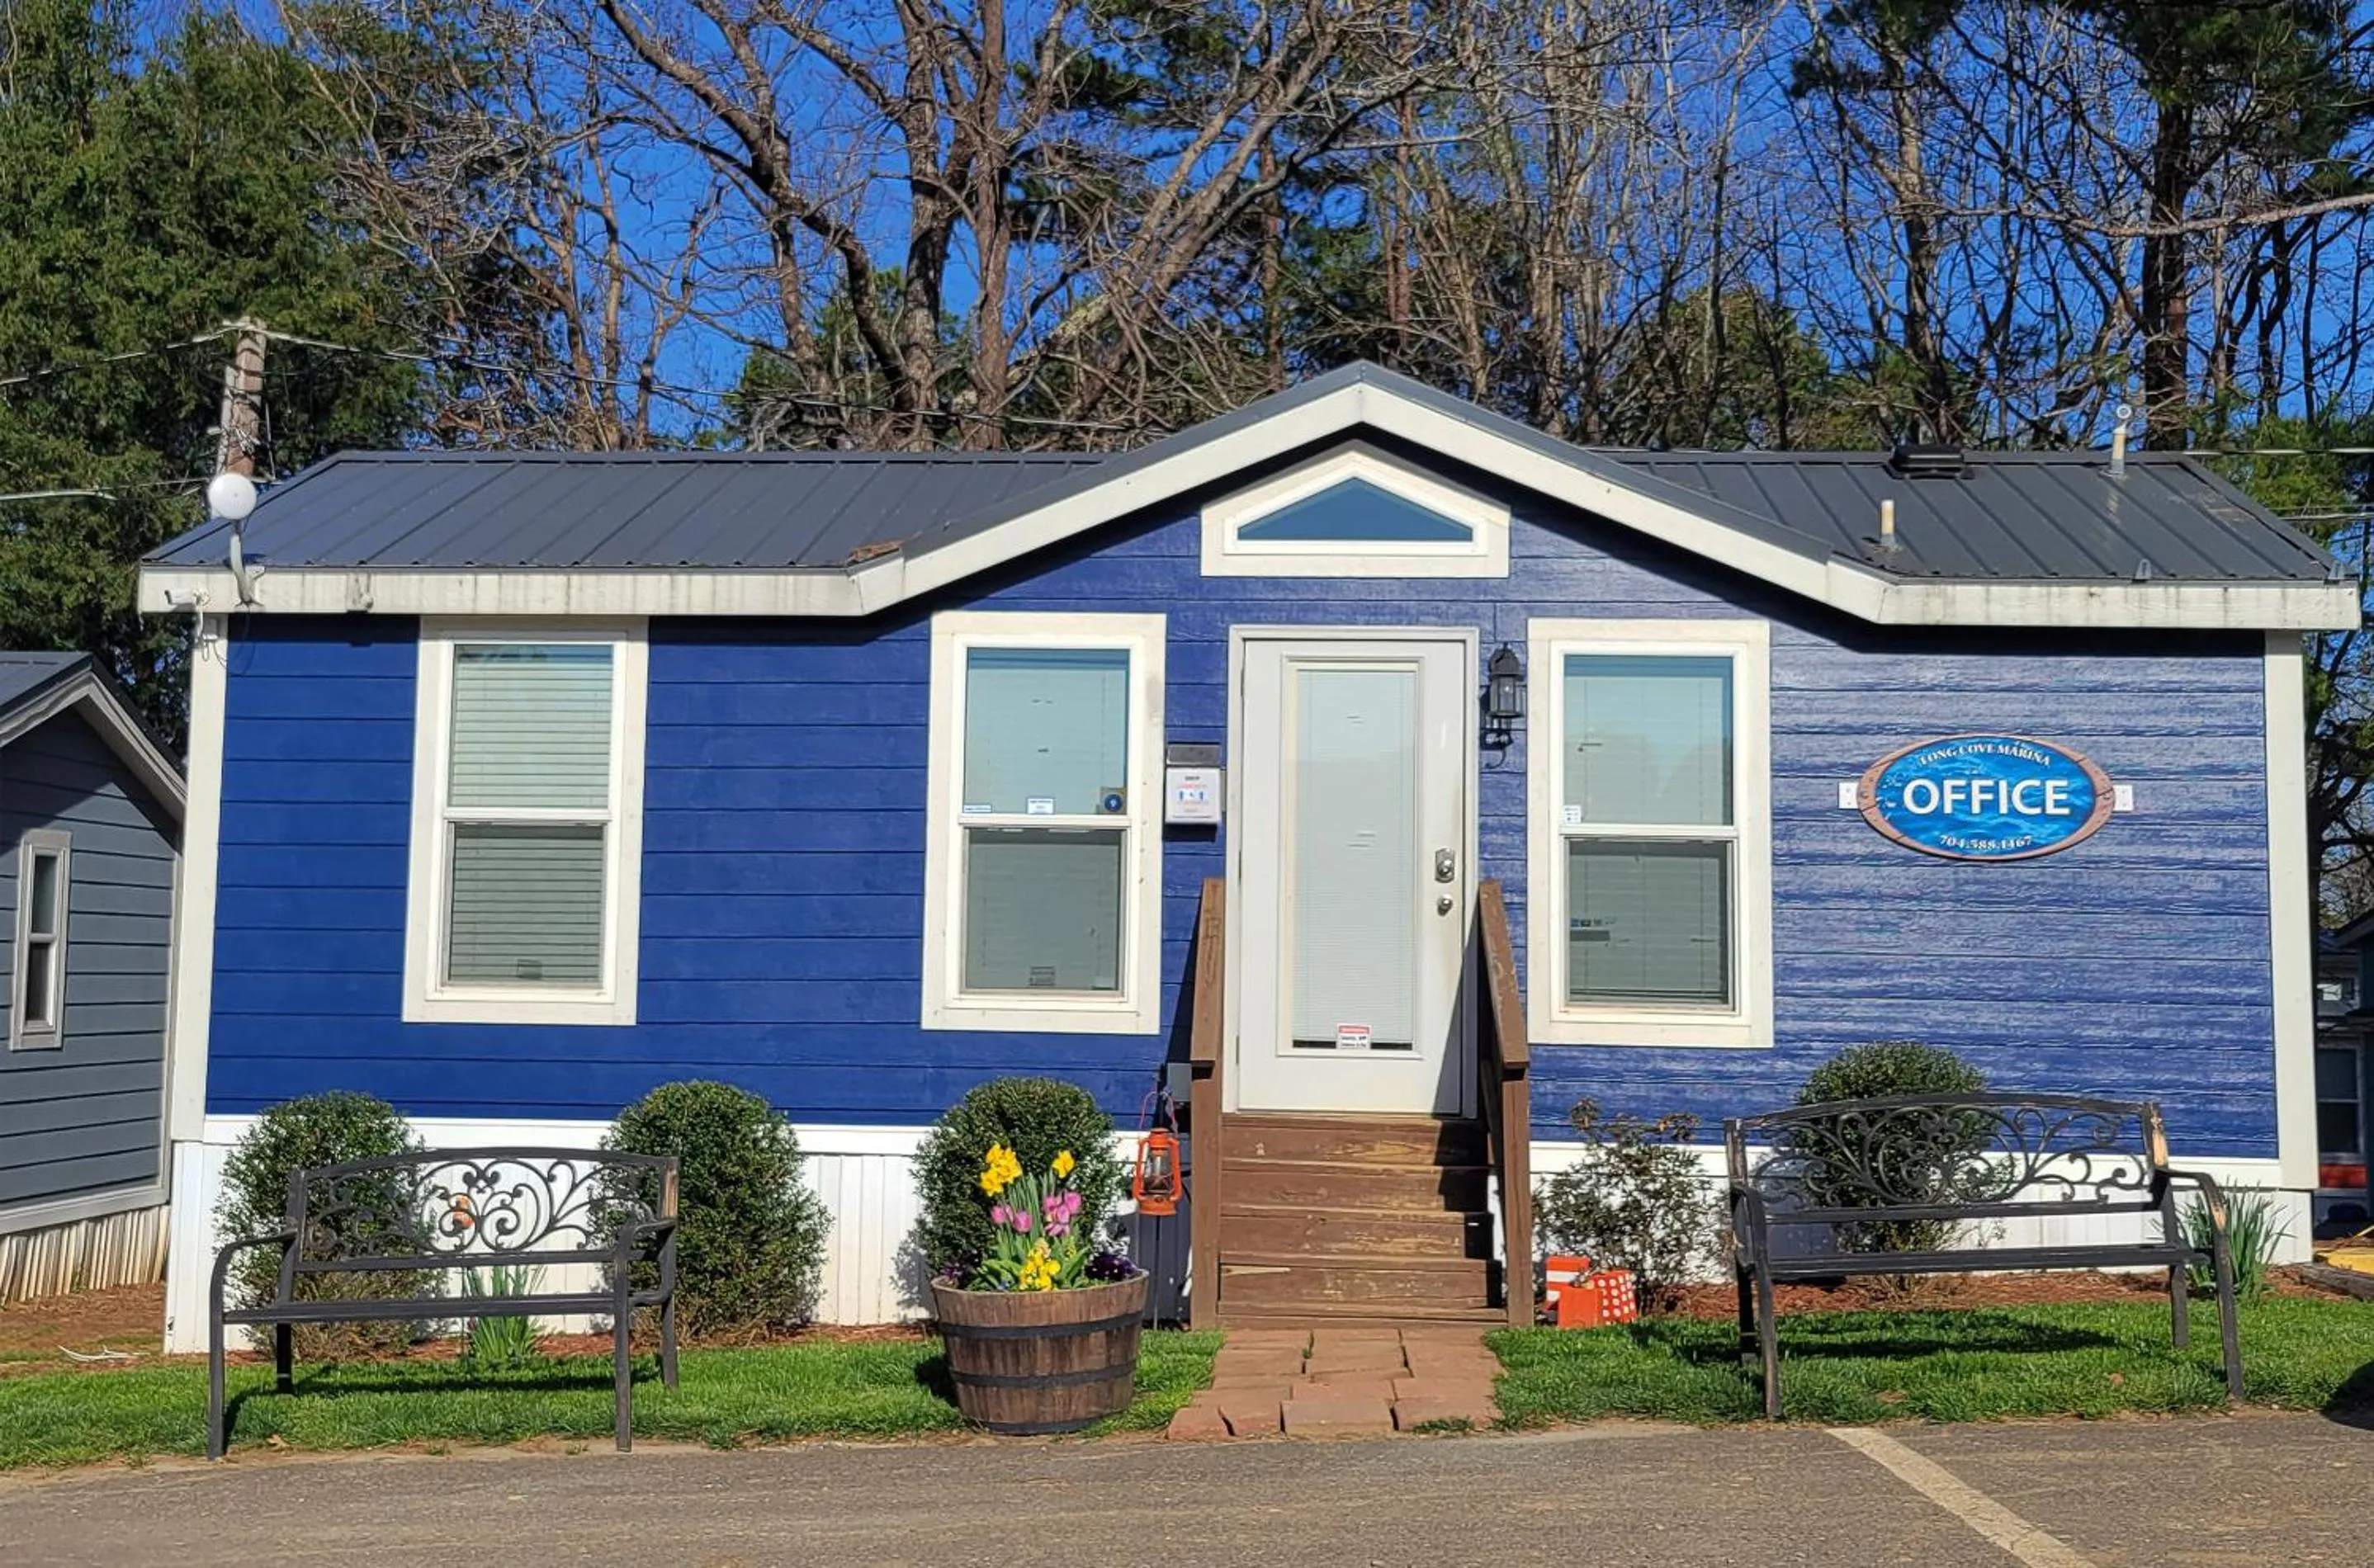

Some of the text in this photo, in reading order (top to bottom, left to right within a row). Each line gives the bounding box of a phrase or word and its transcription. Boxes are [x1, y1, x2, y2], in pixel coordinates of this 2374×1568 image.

[1919, 744, 2050, 767] LONG COVE MARINA
[1903, 778, 2070, 815] OFFICE
